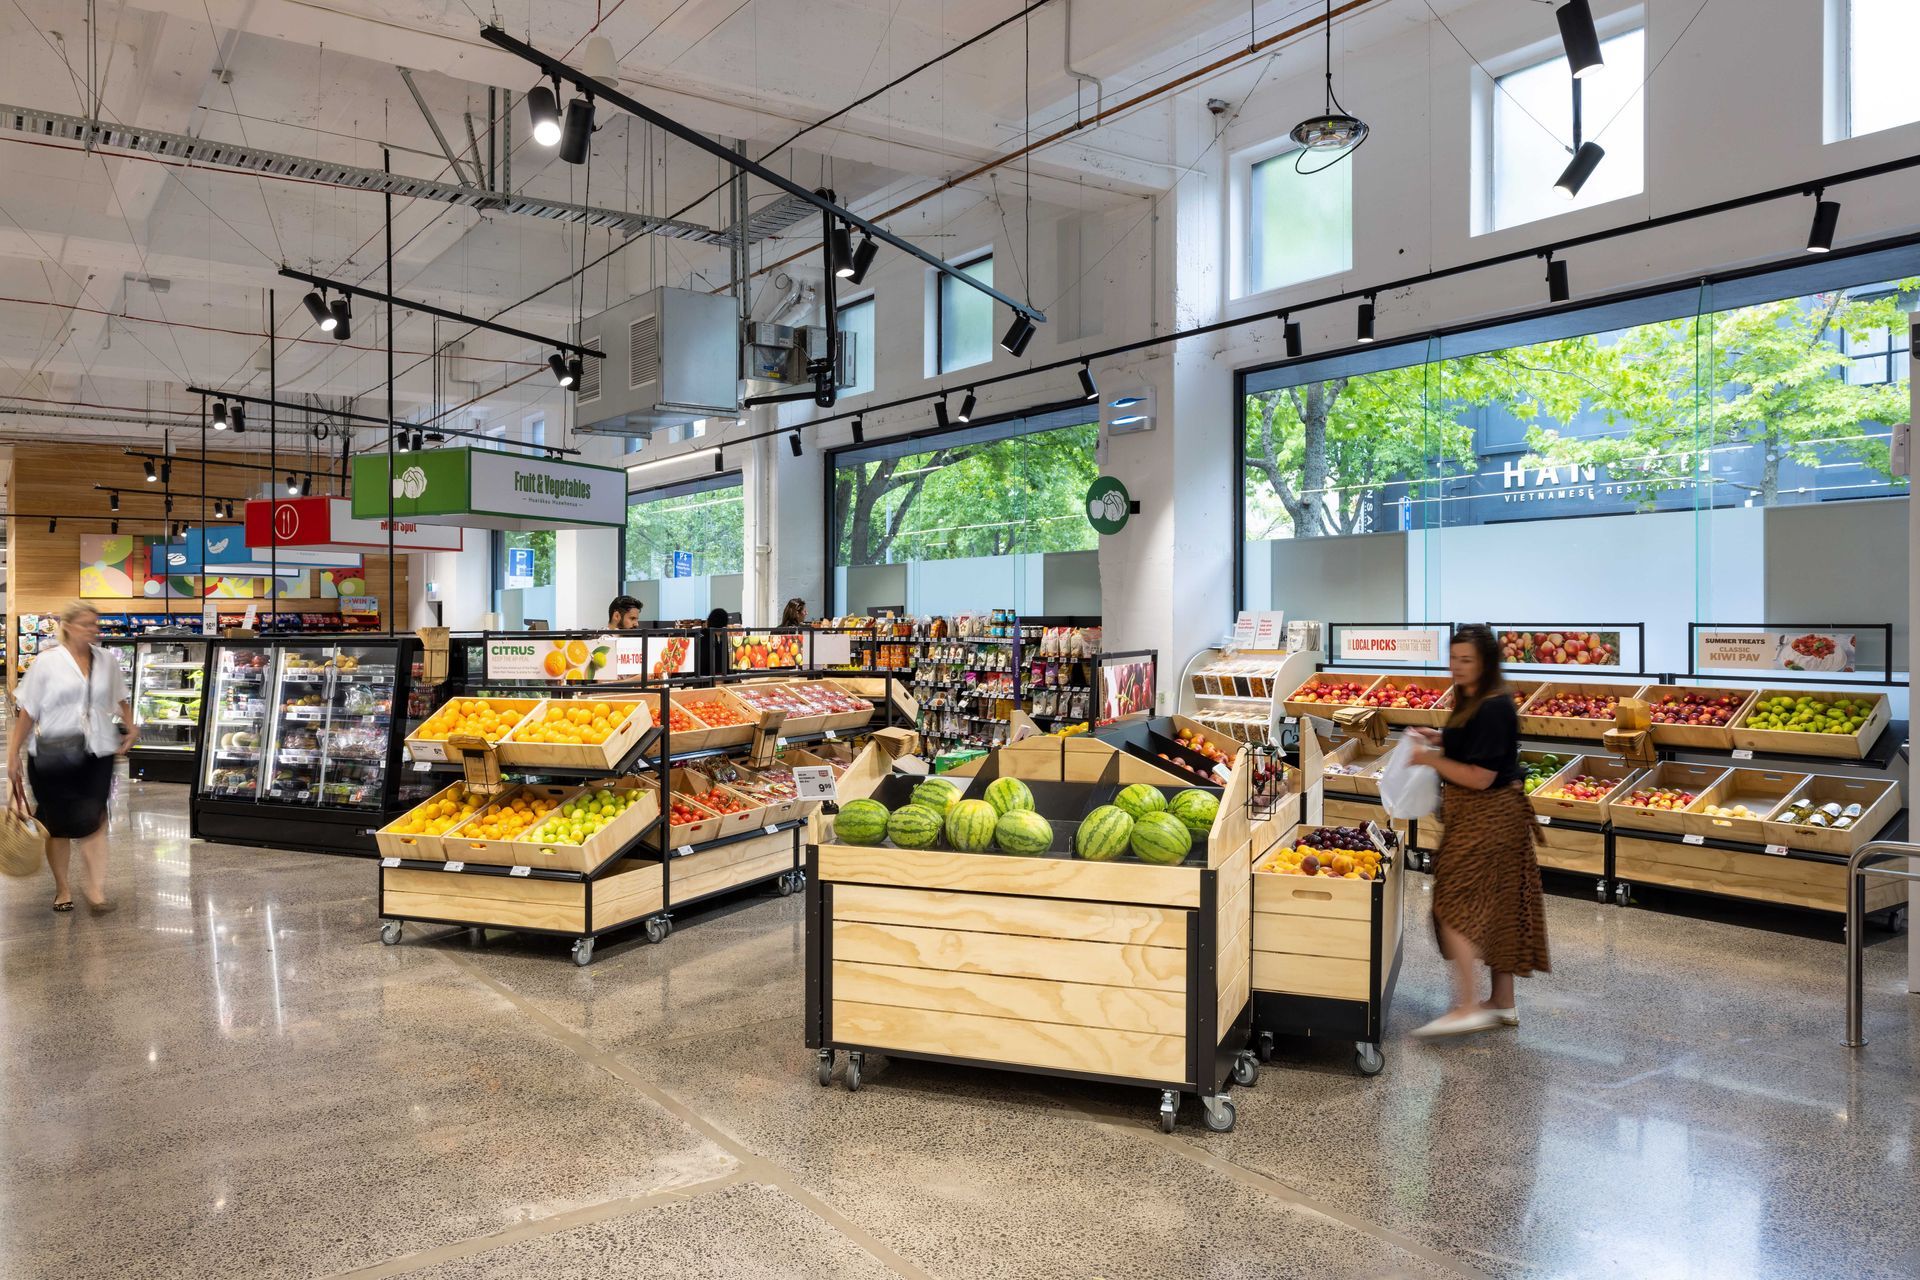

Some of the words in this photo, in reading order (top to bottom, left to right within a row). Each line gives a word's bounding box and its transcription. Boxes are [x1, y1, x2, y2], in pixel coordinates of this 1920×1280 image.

[514, 471, 536, 493] Fruit
[537, 474, 543, 494] &
[545, 474, 591, 499] Vegetables
[1504, 488, 1594, 503] VIETNAMESE
[516, 551, 527, 562] P
[1352, 639, 1370, 651] LOCAL
[1371, 639, 1397, 651] PICKS
[491, 646, 535, 656] CITRUS
[1710, 652, 1736, 661] KIWI
[1738, 653, 1760, 662] PAV
